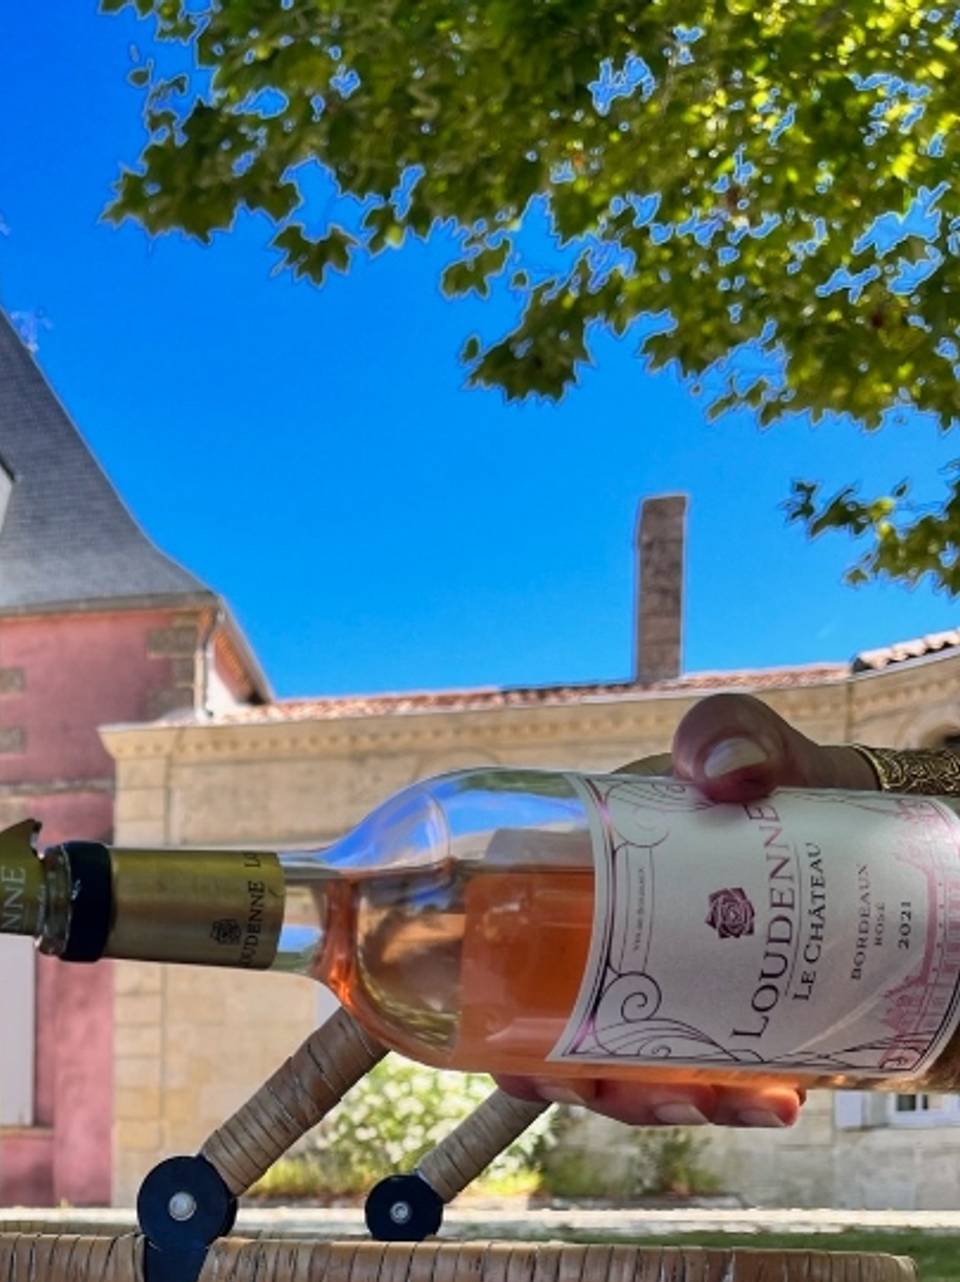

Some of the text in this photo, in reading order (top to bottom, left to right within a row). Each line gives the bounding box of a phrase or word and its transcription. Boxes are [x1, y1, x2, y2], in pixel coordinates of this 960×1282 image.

[730, 803, 796, 1039] LOUDENNE
[793, 842, 827, 1001] LE CHÂTEAU
[851, 862, 871, 982] BORDEAUX
[897, 900, 912, 950] 2021
